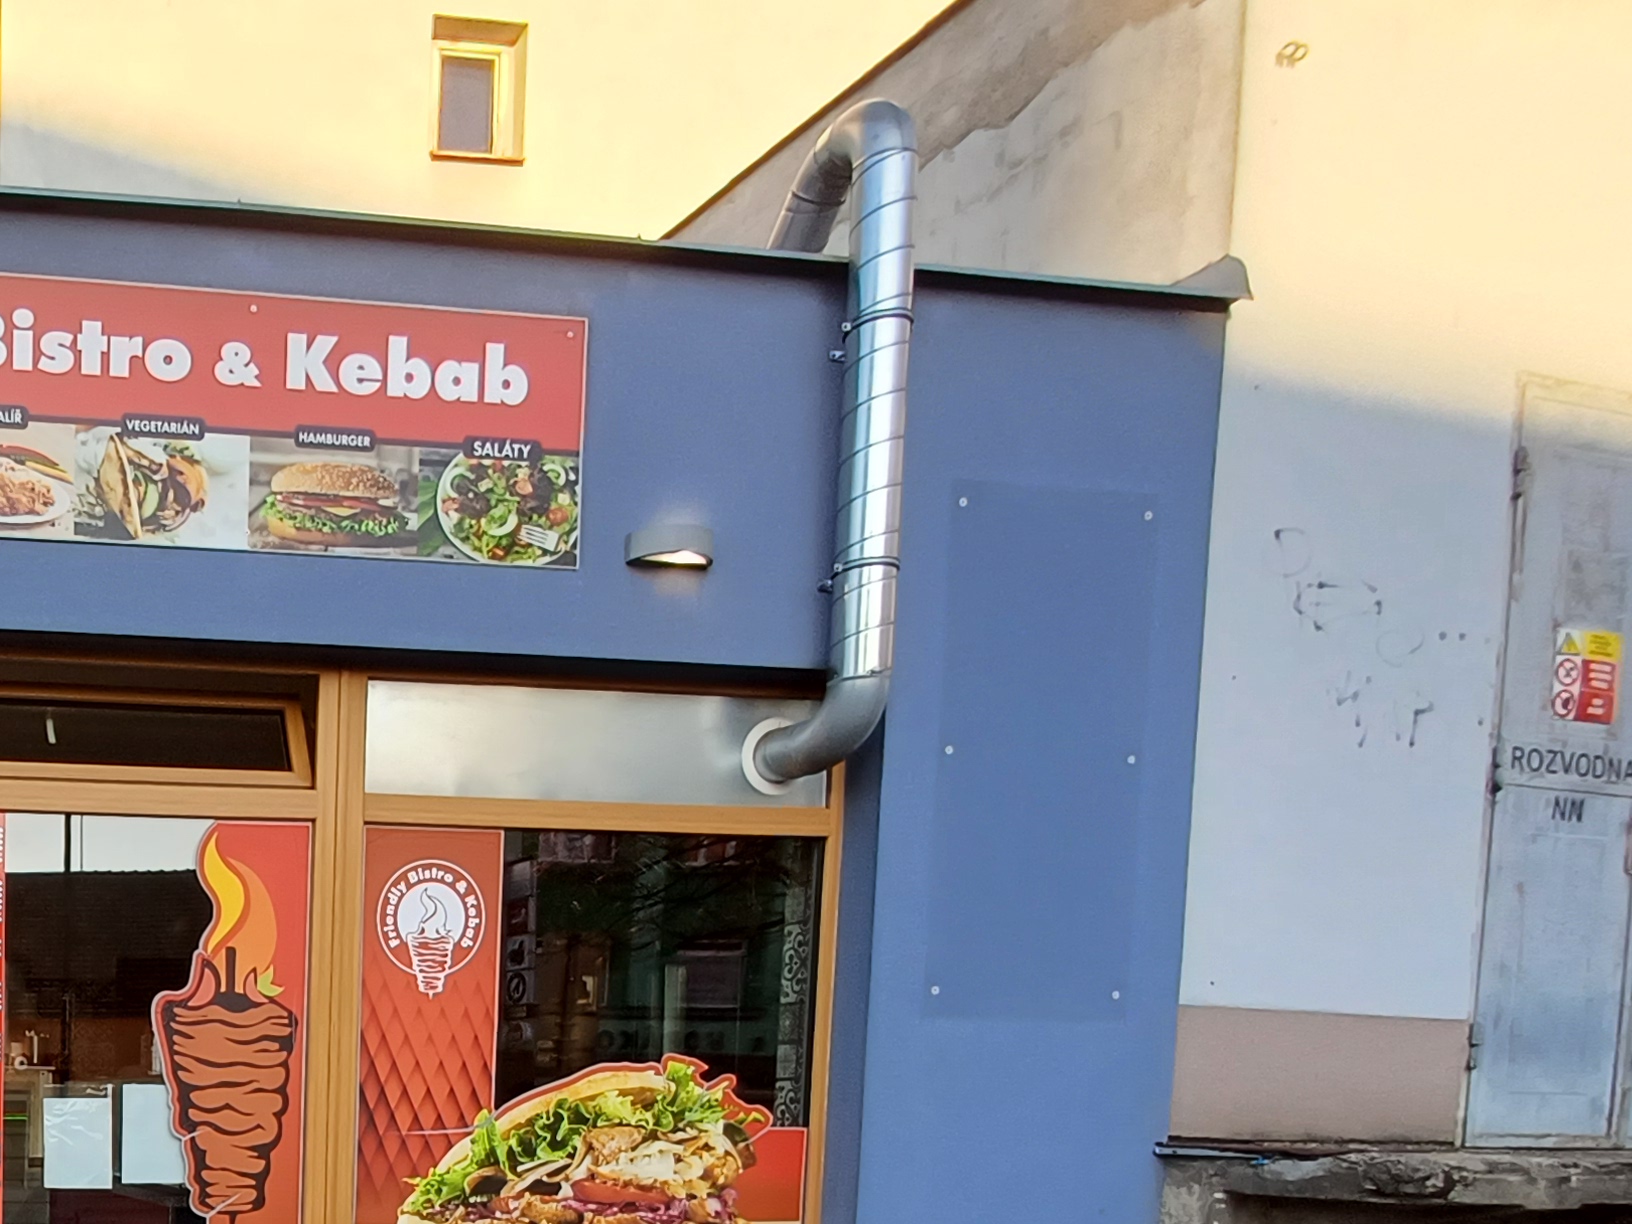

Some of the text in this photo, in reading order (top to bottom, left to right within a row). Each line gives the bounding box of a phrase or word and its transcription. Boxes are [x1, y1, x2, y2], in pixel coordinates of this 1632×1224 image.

[214, 342, 262, 387] &
[286, 332, 528, 406] Kebab
[126, 419, 200, 435] VEGETARIÁN
[299, 432, 371, 448] HAMBURGER
[473, 438, 531, 459] SALÁTY
[1551, 796, 1584, 822] NN
[383, 867, 480, 948] Friendly Bistro & Kebab
